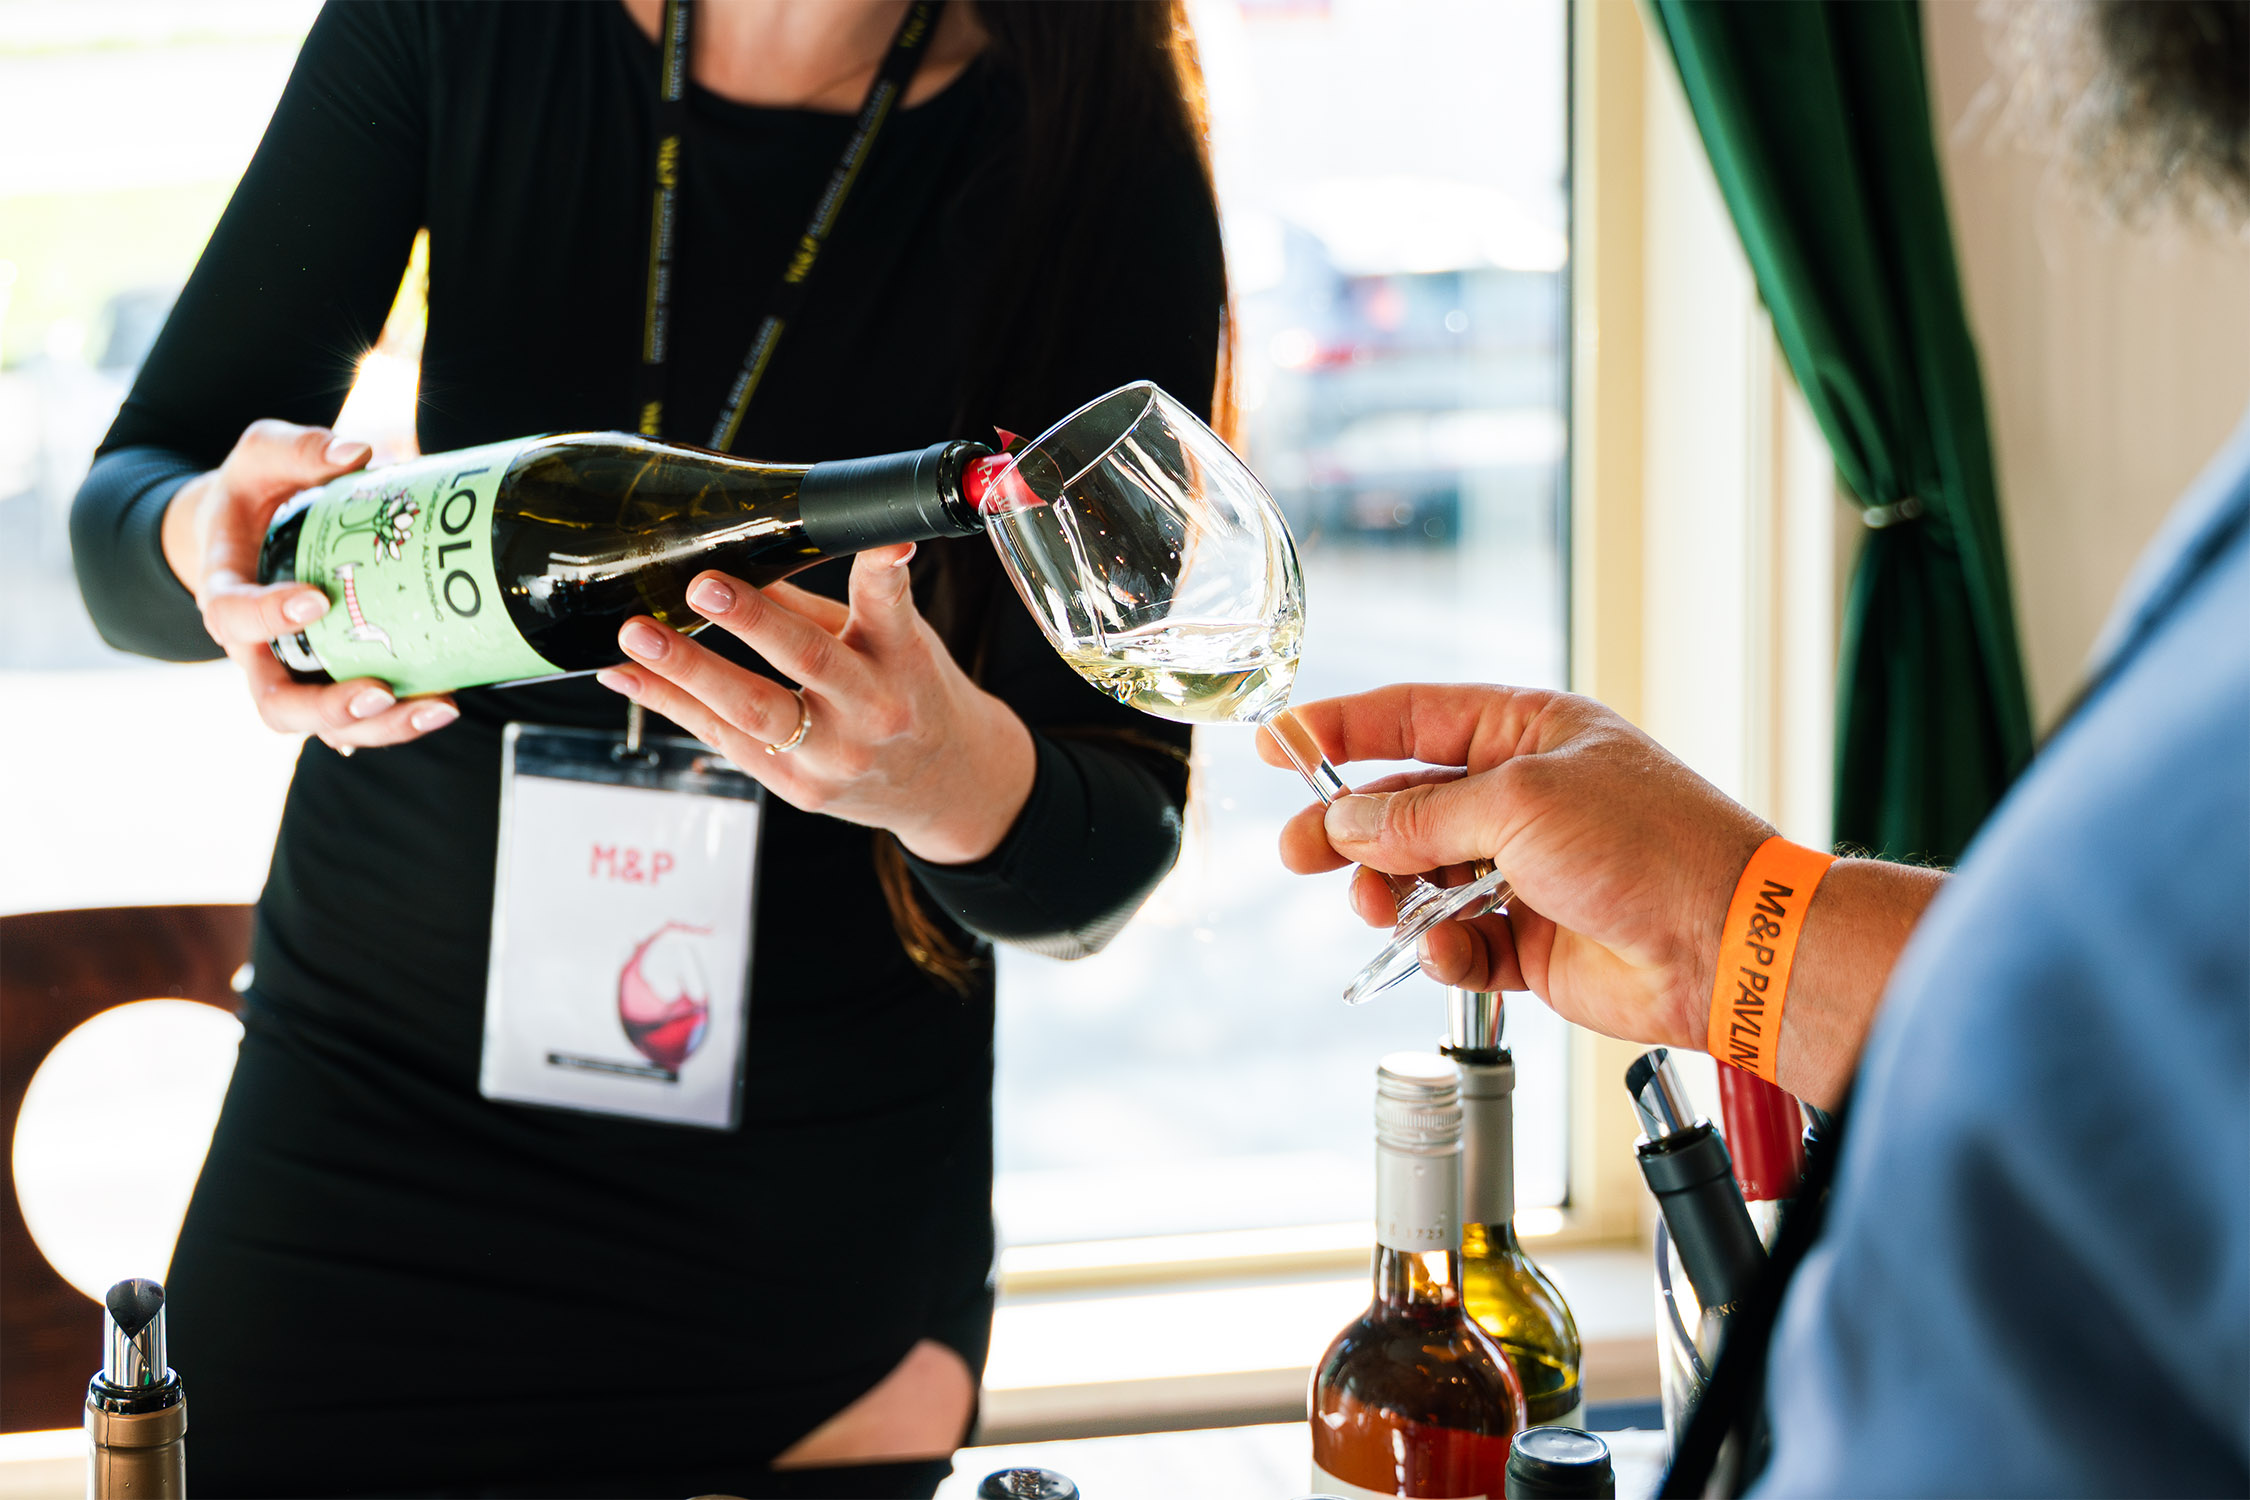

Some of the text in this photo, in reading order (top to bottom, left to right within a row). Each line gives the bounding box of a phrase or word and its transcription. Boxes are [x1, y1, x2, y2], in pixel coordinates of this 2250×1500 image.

[437, 466, 492, 619] LOLO
[590, 841, 677, 885] M&P
[1729, 879, 1794, 1077] M&P PAVLIN
